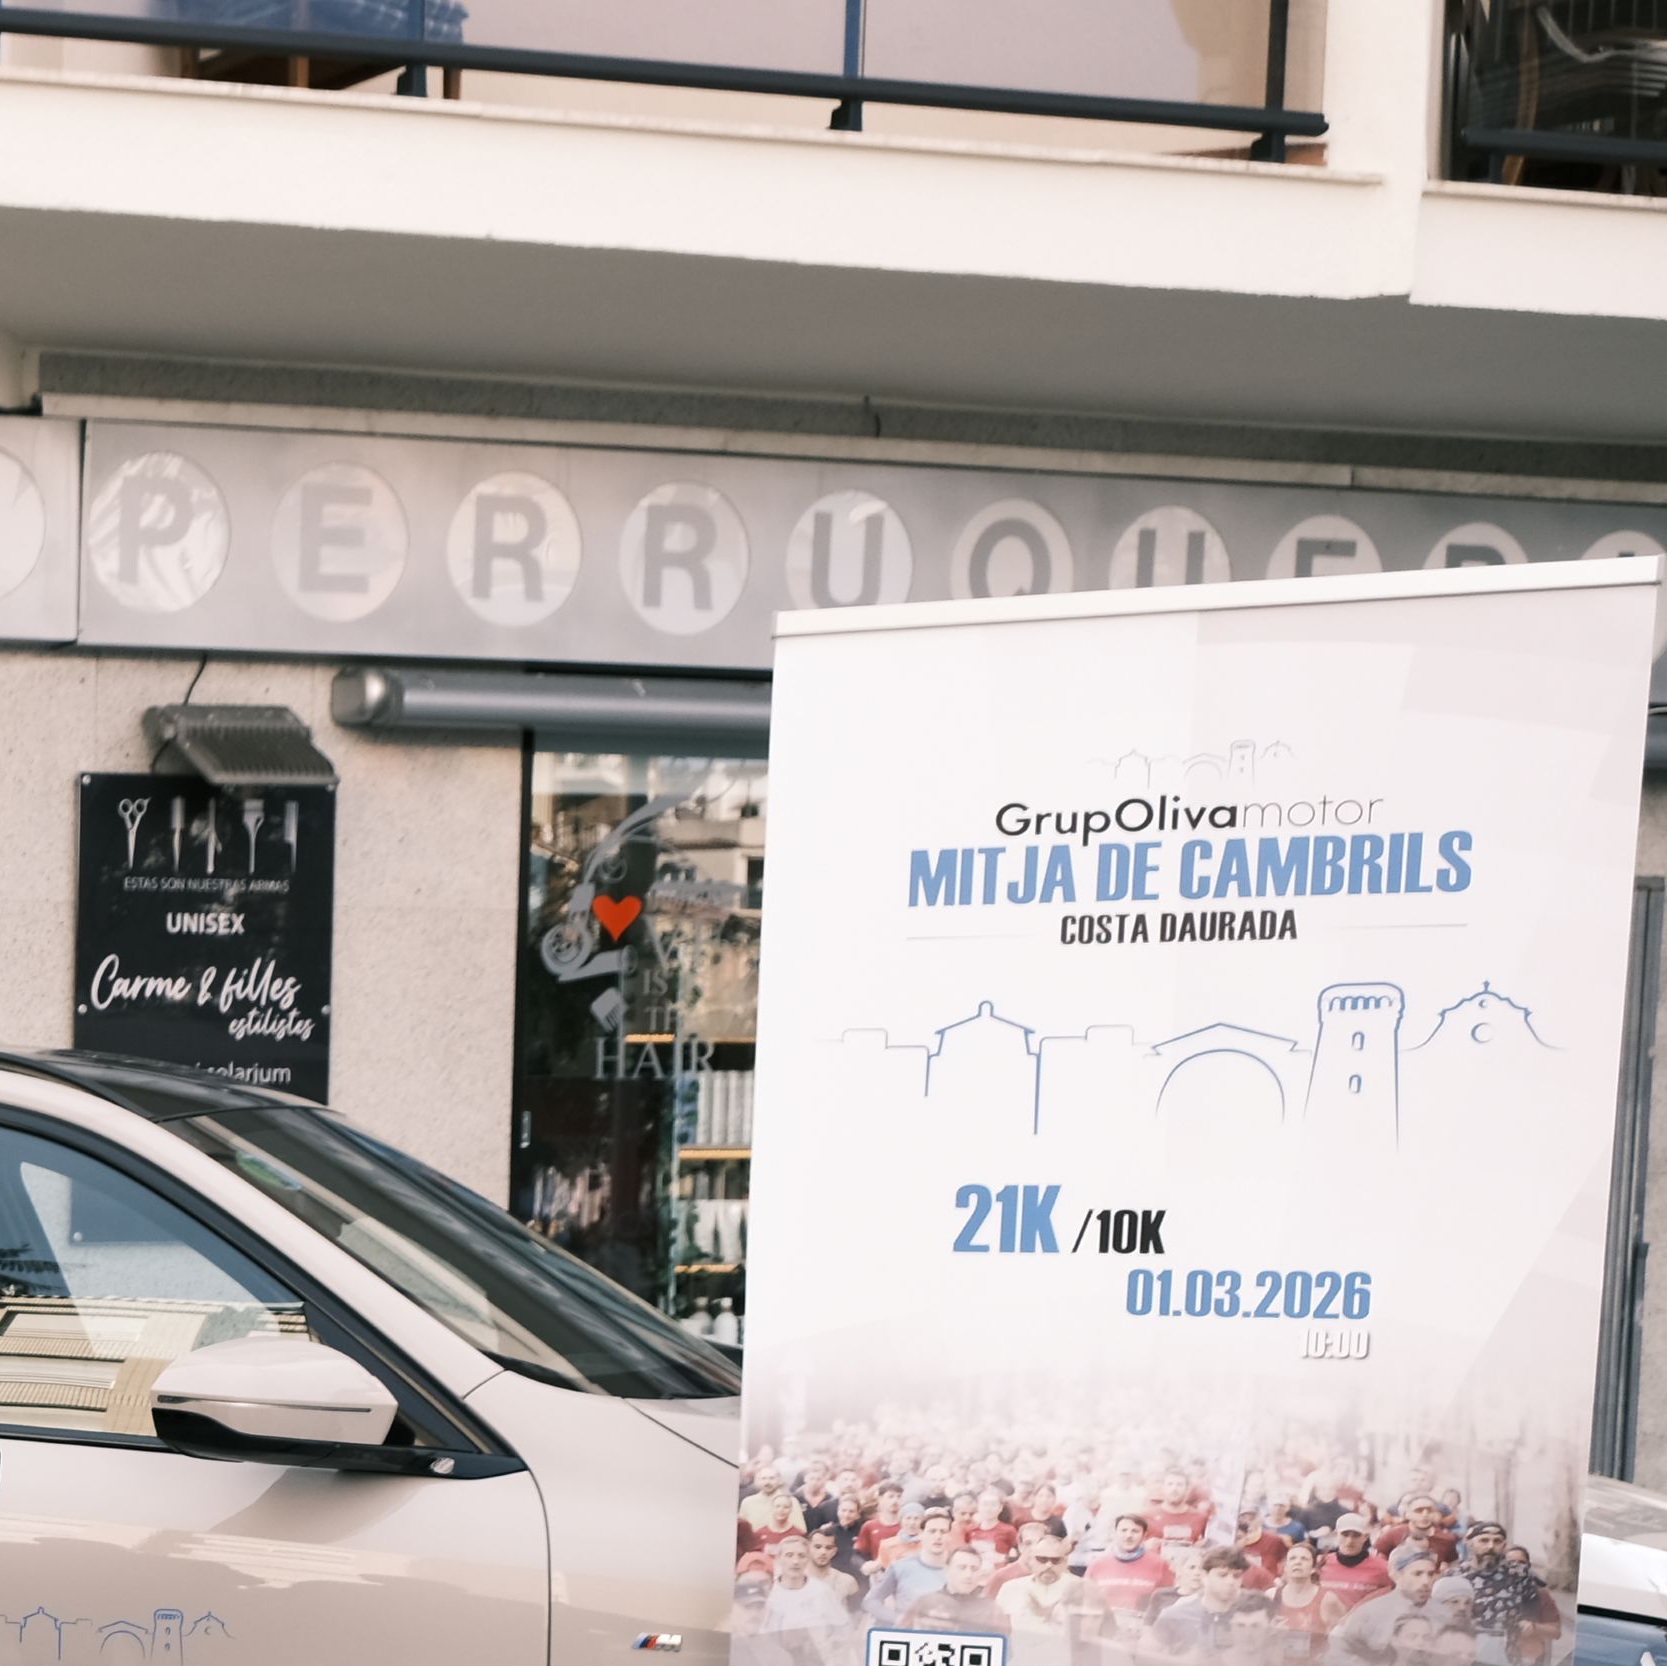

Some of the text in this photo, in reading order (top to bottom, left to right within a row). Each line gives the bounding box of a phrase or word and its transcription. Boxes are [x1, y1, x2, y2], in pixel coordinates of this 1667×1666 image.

[995, 795, 1384, 847] GrupOlivamotor
[907, 830, 1473, 908] MITJA DE CAMBRILS
[166, 912, 245, 935] UNISEX
[1059, 909, 1298, 945] COSTA DAURADA
[91, 953, 192, 1011] Carme
[219, 957, 301, 1014] filles
[228, 1006, 316, 1041] estilistes
[953, 1184, 1062, 1253] 21K
[1126, 1268, 1372, 1320] 01.03.2026
[1300, 1328, 1371, 1360] 10:00
